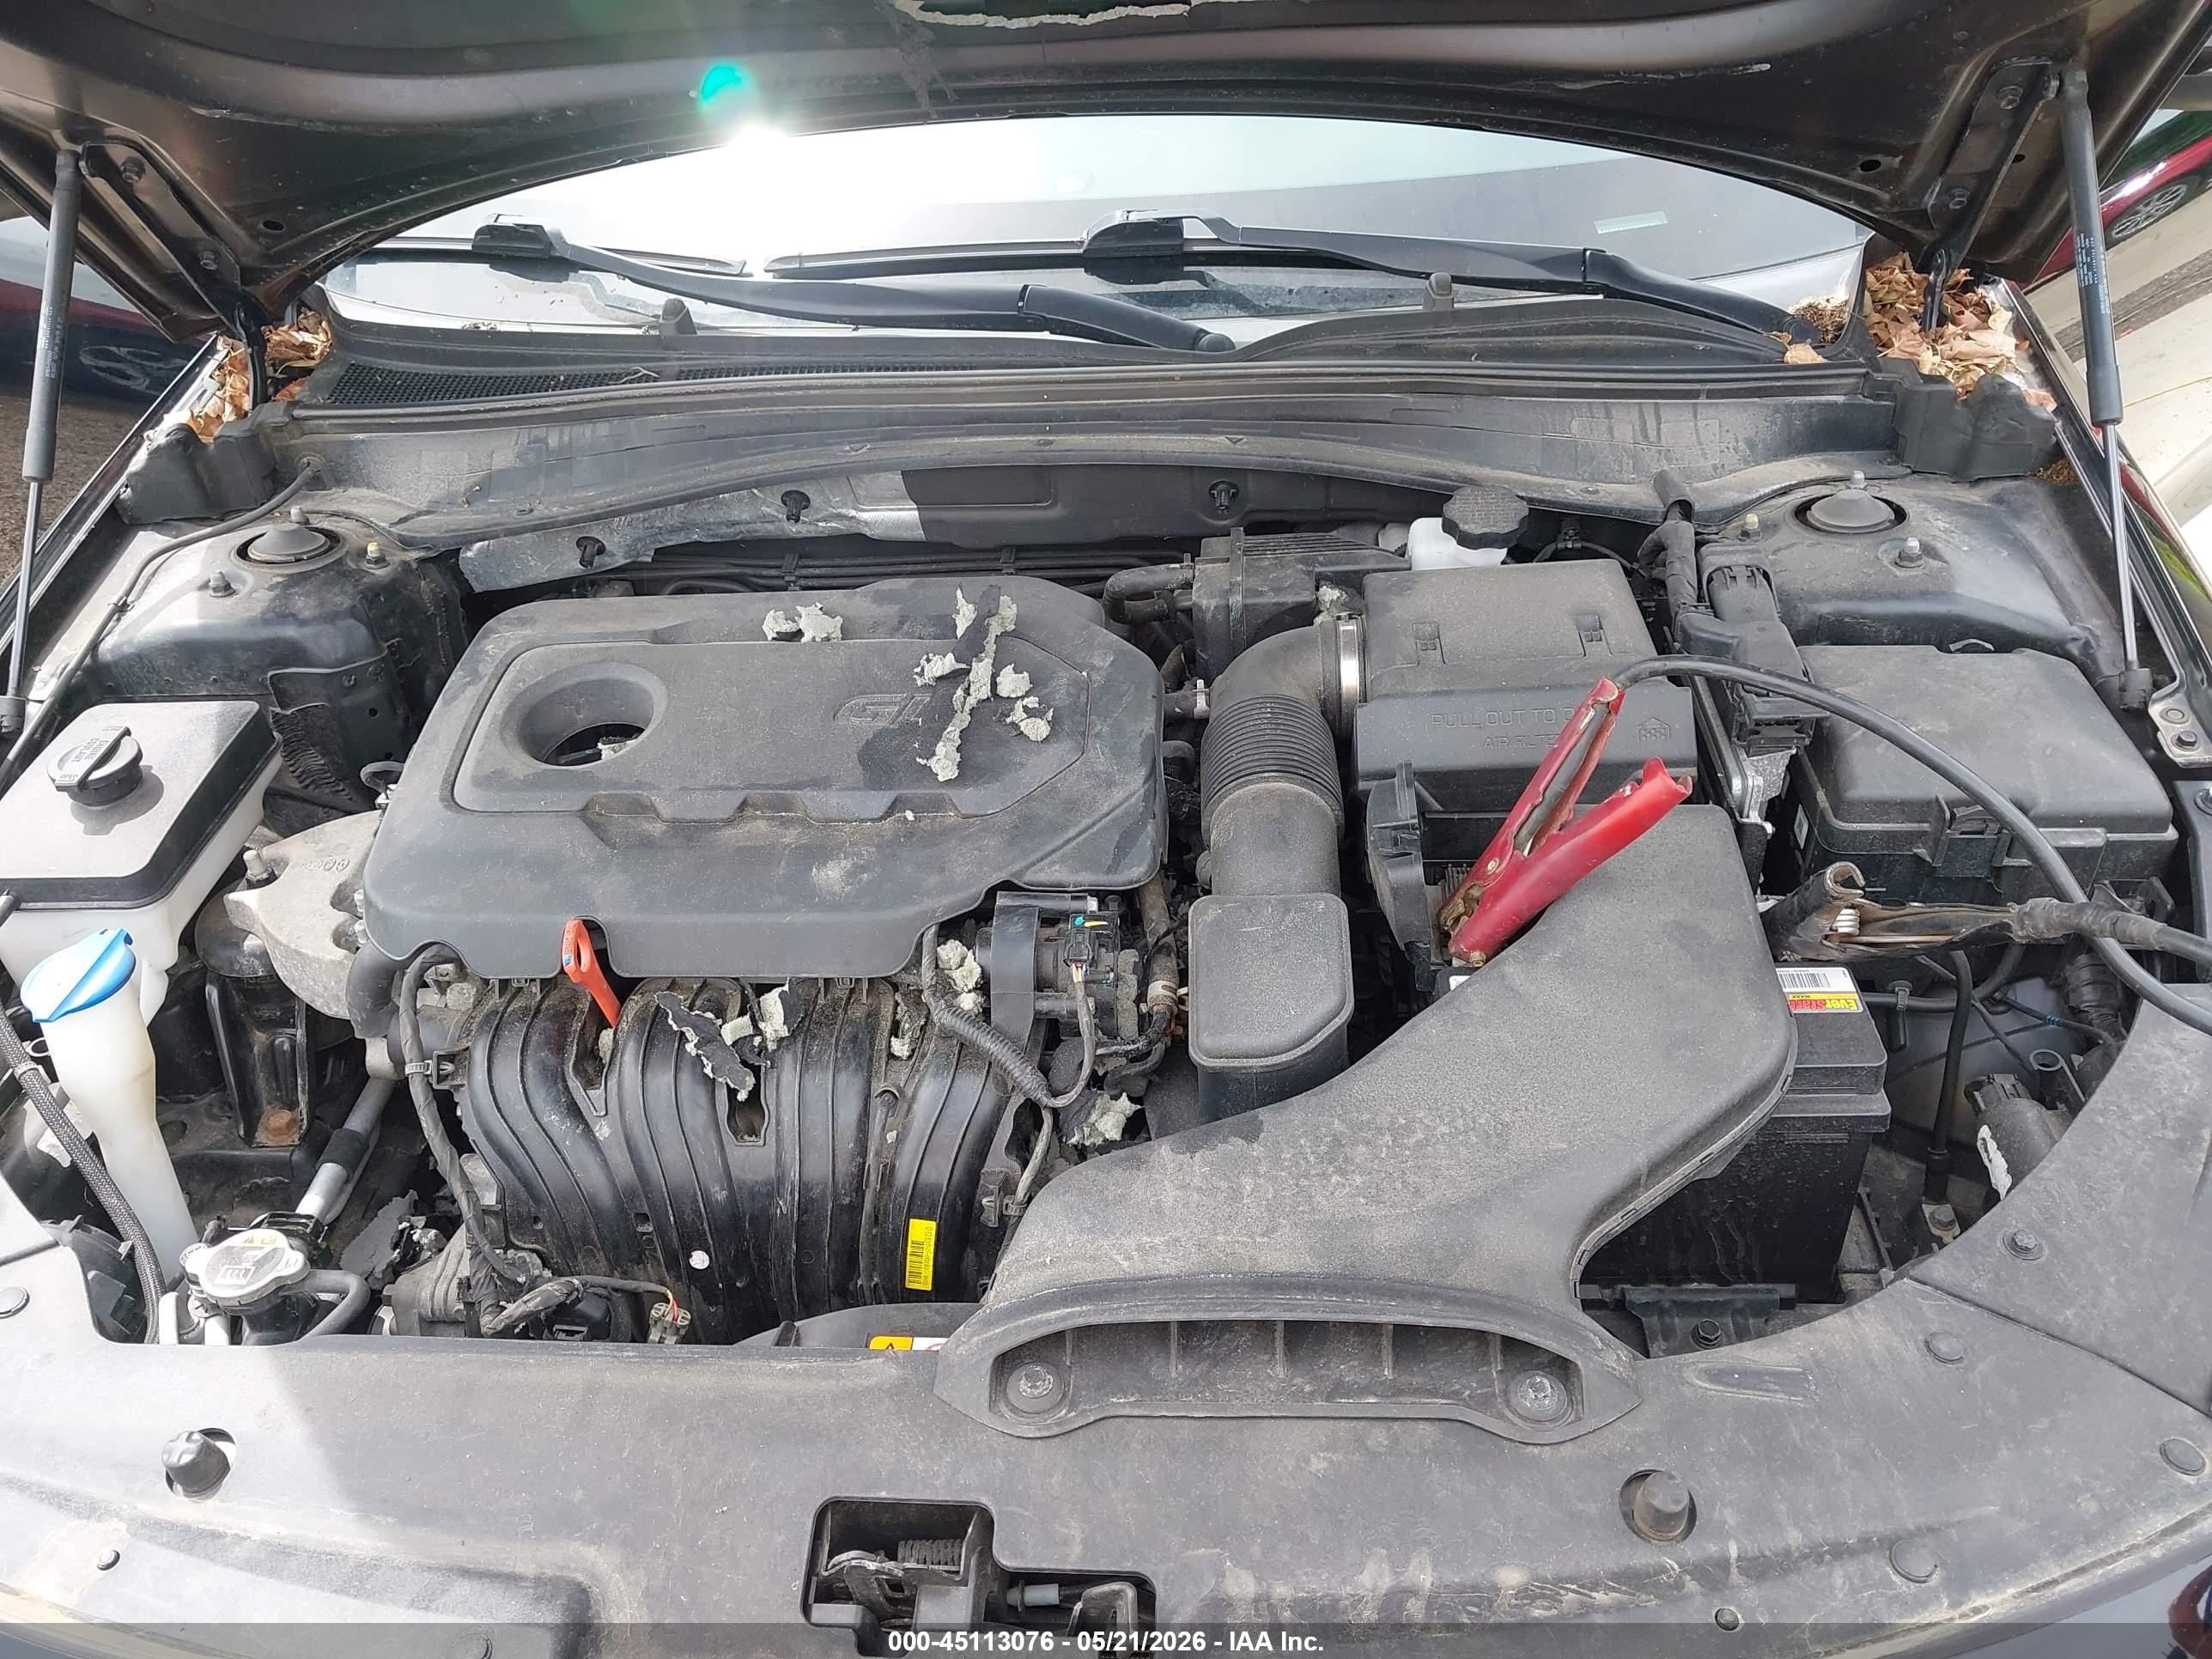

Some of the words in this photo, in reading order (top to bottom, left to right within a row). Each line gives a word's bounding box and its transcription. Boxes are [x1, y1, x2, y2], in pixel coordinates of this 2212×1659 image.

[1431, 713, 1482, 729] PULL
[1485, 710, 1526, 726] OUT
[1533, 708, 1555, 724] TO
[70, 738, 100, 763] COOLANT
[1483, 736, 1509, 750] AIR
[1514, 733, 1559, 749] FILTE
